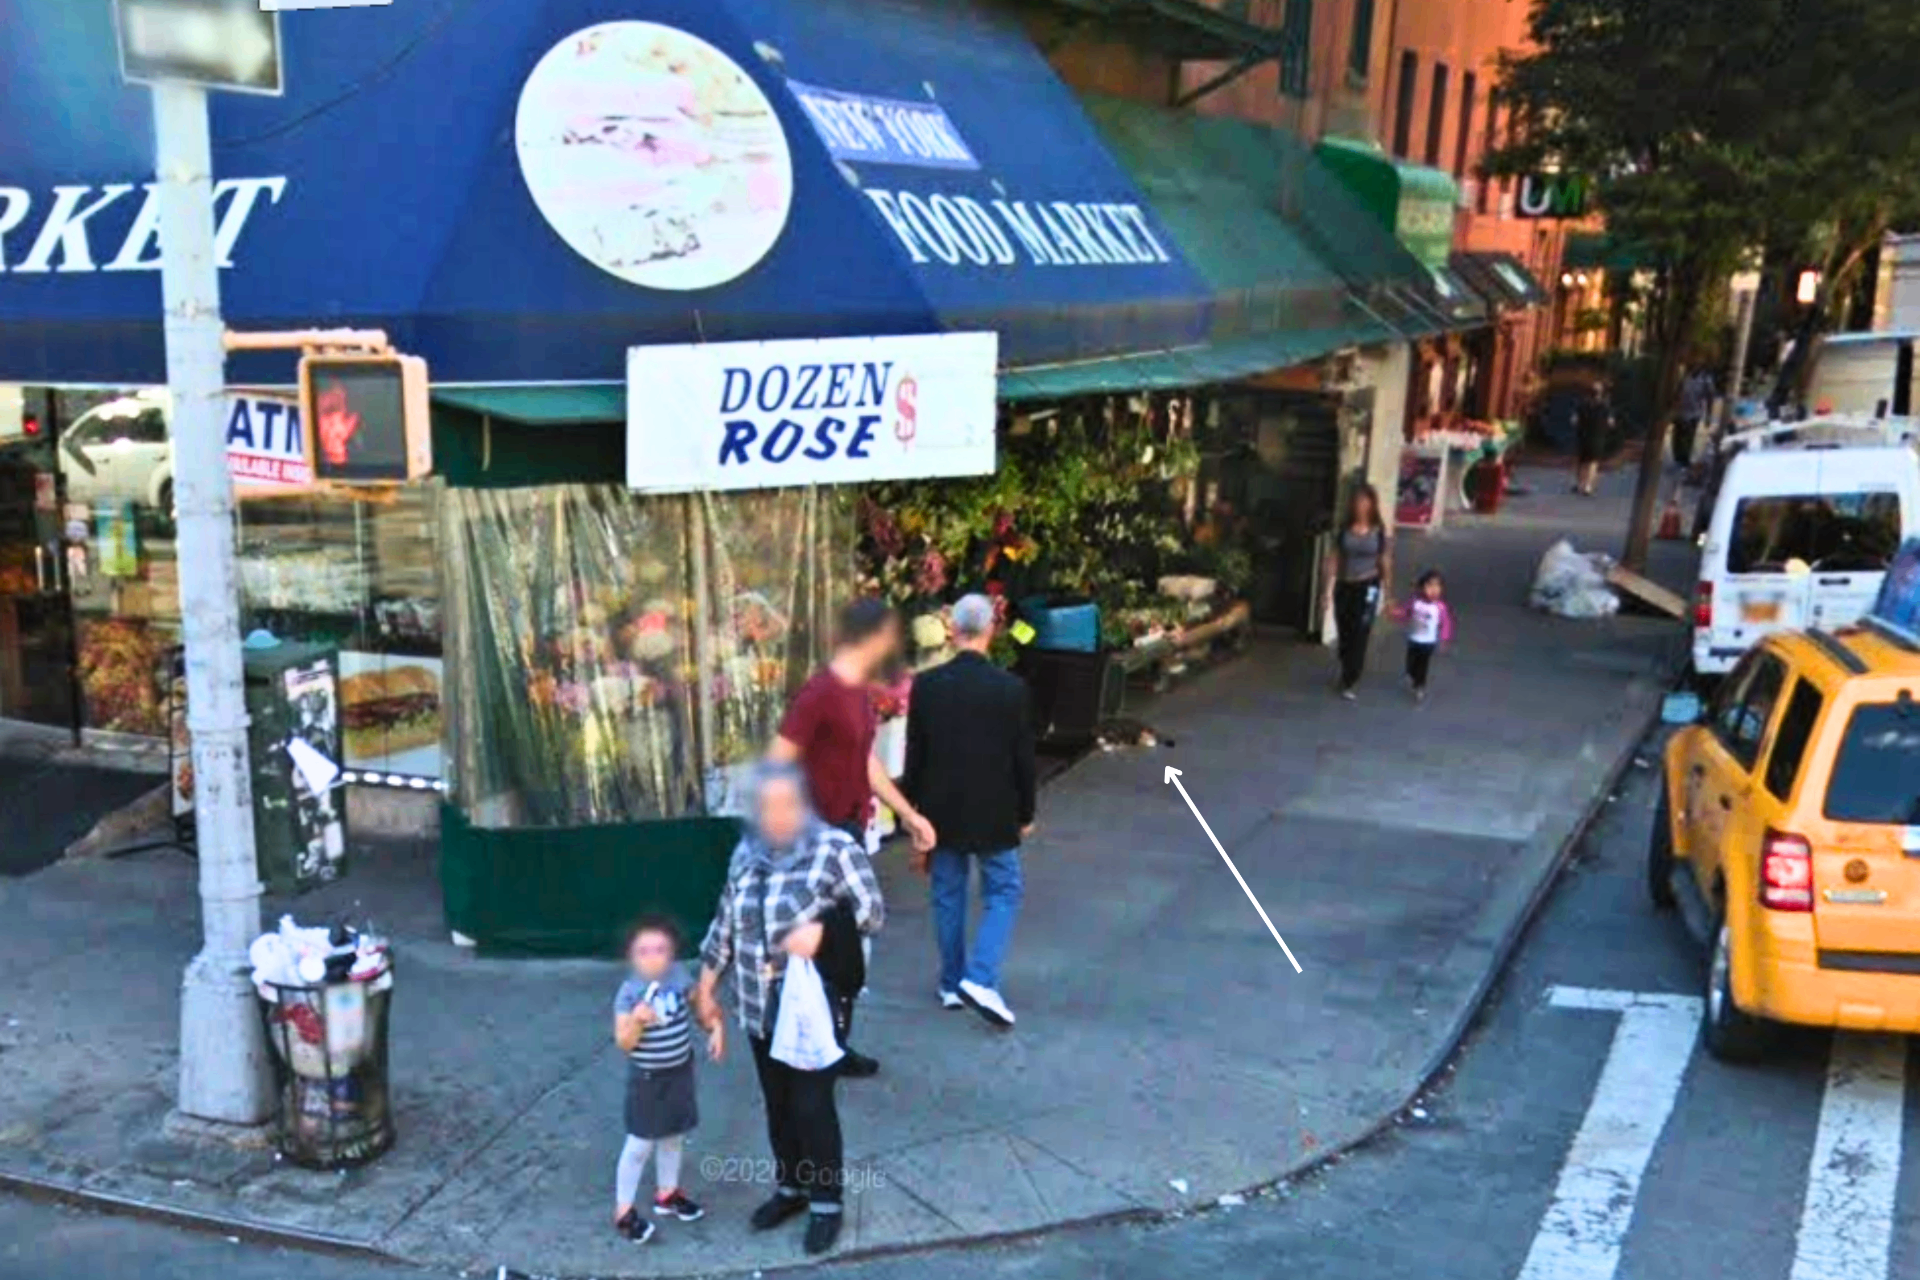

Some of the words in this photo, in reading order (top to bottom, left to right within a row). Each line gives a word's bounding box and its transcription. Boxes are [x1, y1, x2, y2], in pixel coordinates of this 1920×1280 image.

[800, 95, 885, 150] NEW
[873, 104, 971, 160] YORK
[862, 188, 1015, 265] FOOD
[991, 199, 1170, 265] MARKET
[719, 361, 894, 415] DOZEN
[718, 414, 882, 466] ROSE
